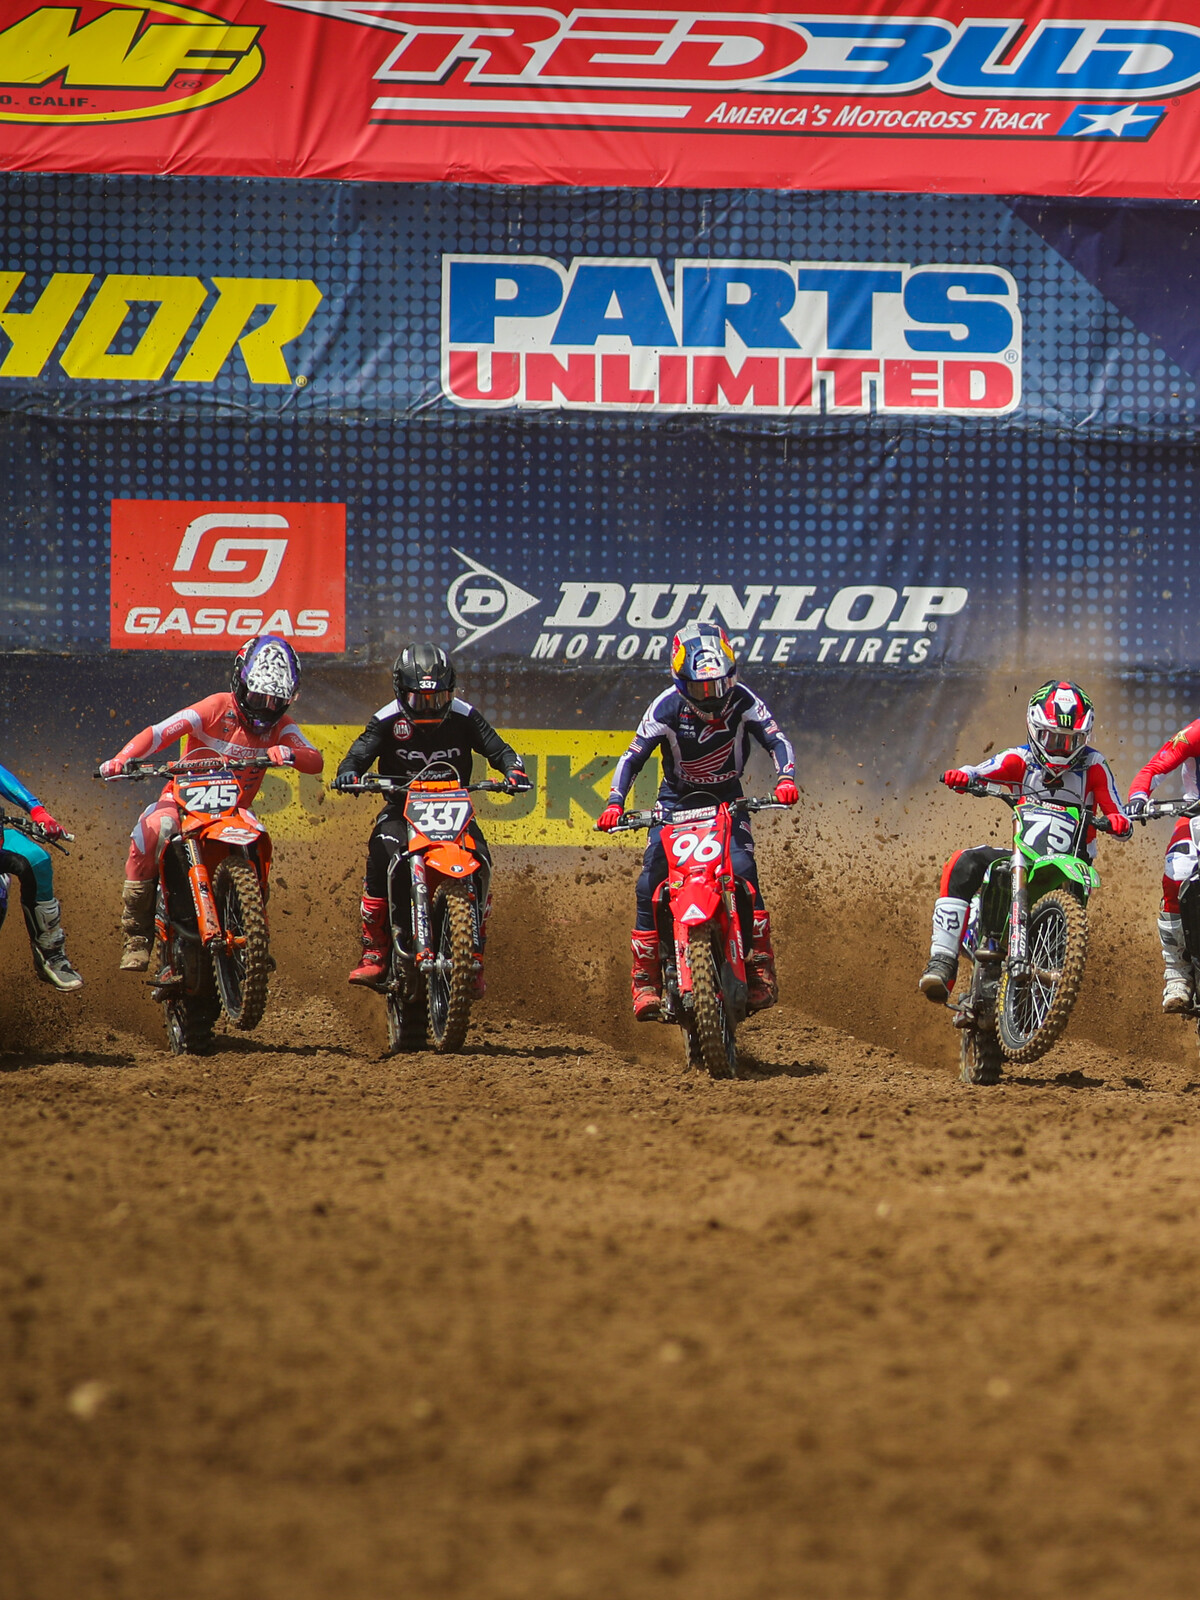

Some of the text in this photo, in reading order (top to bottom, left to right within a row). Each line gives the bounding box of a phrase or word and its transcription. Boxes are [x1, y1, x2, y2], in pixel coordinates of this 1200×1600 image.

[0, 6, 266, 91] MF
[0, 95, 97, 108] O. CALIF.
[446, 258, 1018, 356] PARTS
[0, 271, 323, 385] HOR
[446, 350, 1016, 411] UNLIMITED
[124, 606, 330, 638] GASGAS
[544, 581, 969, 632] DUNLOP
[531, 632, 932, 665] MOTORCLE TIRES
[419, 680, 437, 690] 337
[680, 770, 738, 784] HONDA
[185, 785, 238, 810] 245
[413, 801, 469, 832] 337
[1022, 813, 1076, 853] 75
[672, 831, 722, 867] 96
